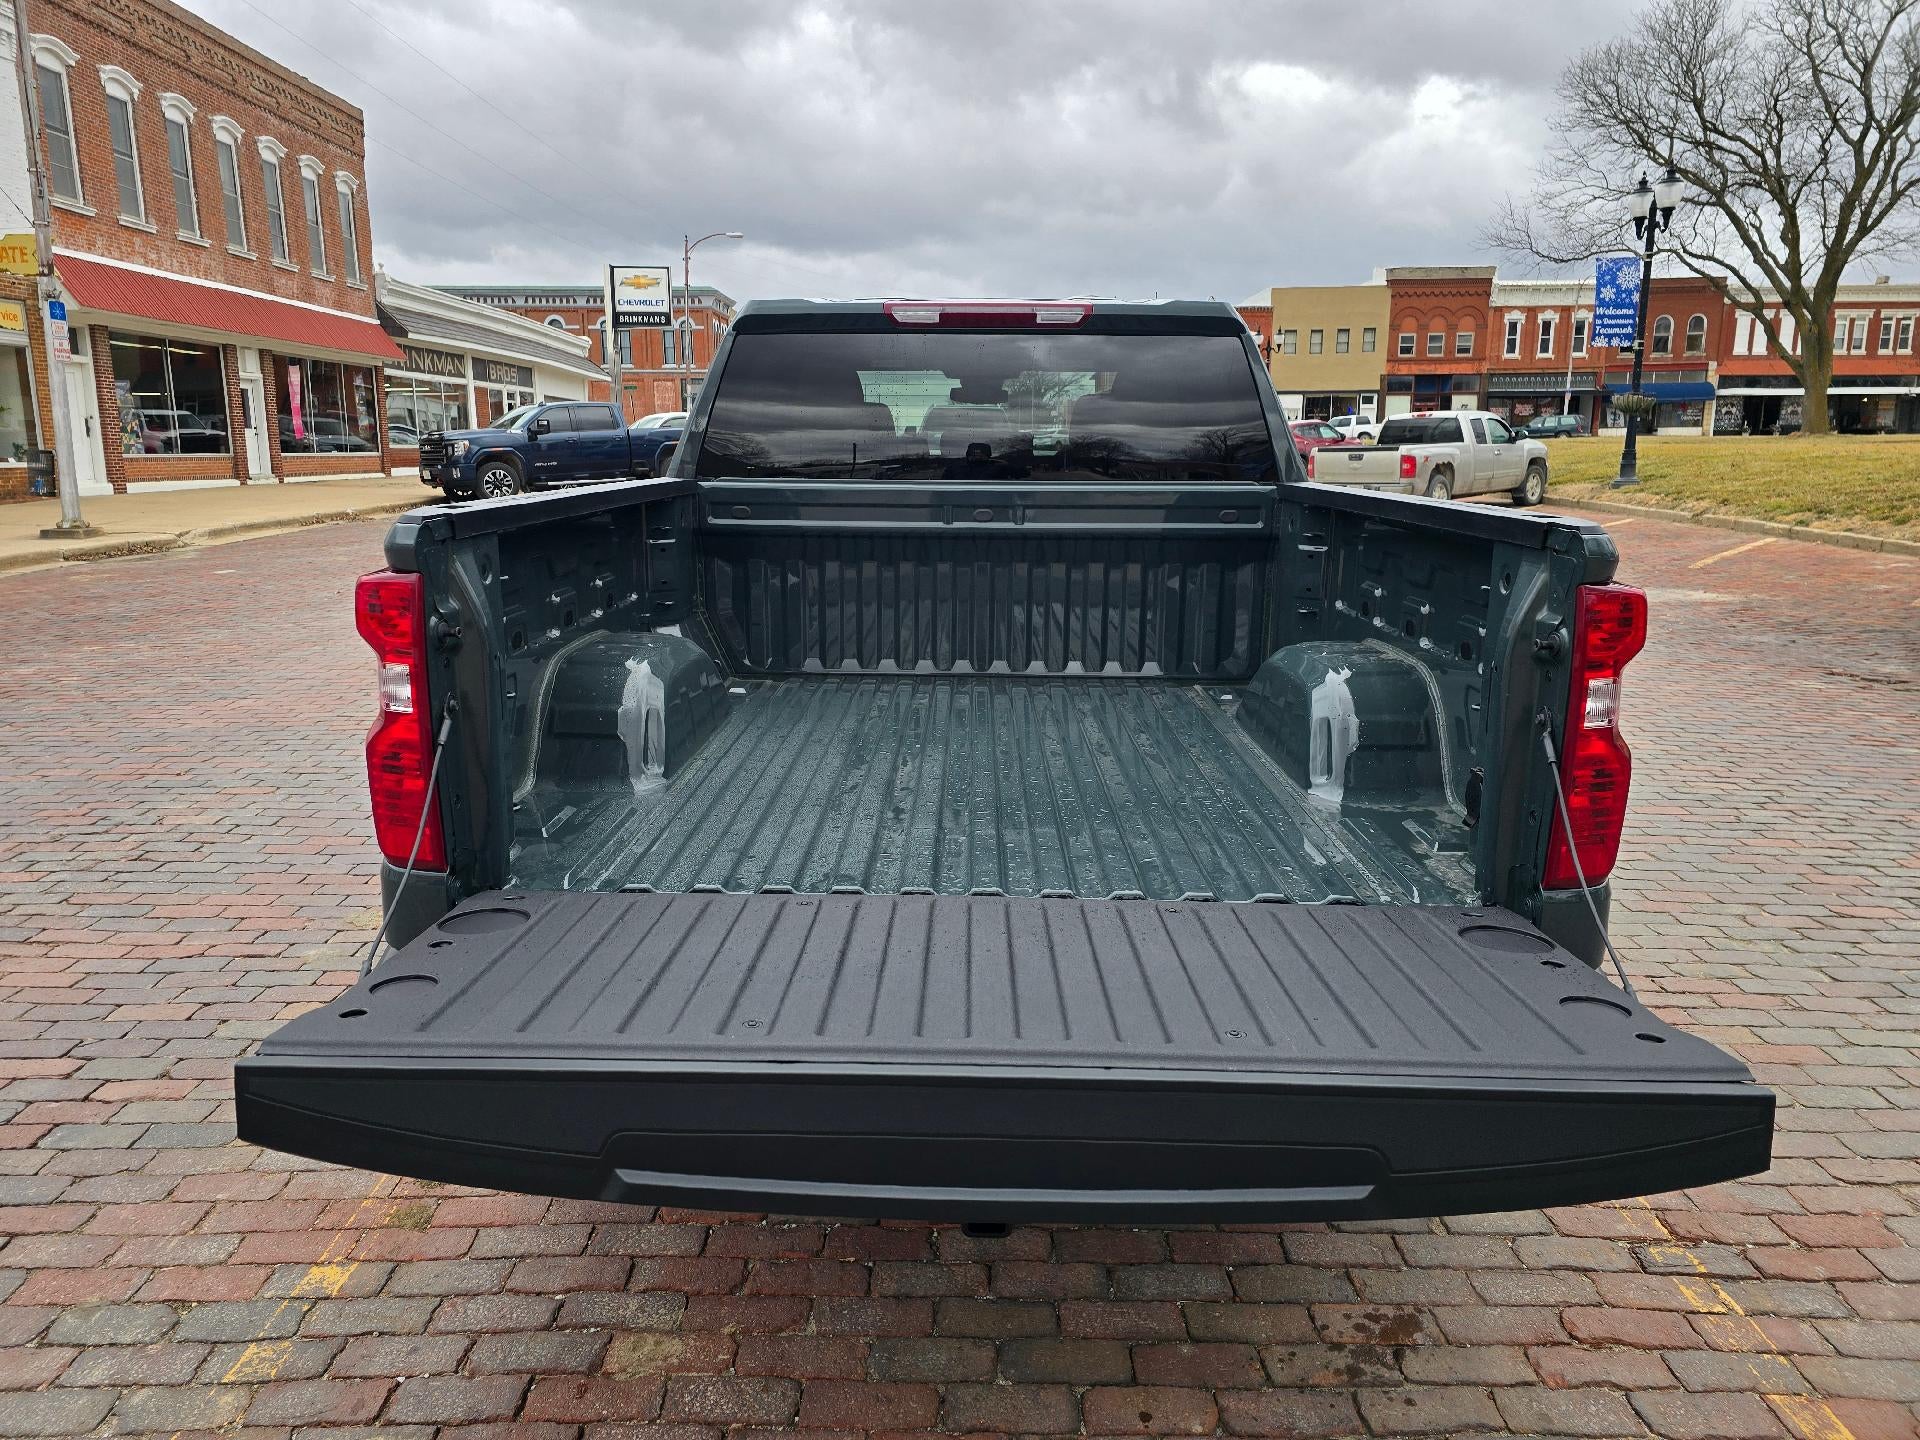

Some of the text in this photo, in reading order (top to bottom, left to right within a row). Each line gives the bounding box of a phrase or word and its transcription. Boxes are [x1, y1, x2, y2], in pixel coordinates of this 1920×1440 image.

[1596, 306, 1635, 315] Welcome
[1603, 317, 1634, 325] Downtown
[1595, 325, 1633, 334] Tecumseh
[386, 348, 517, 383] INKMAN BROS
